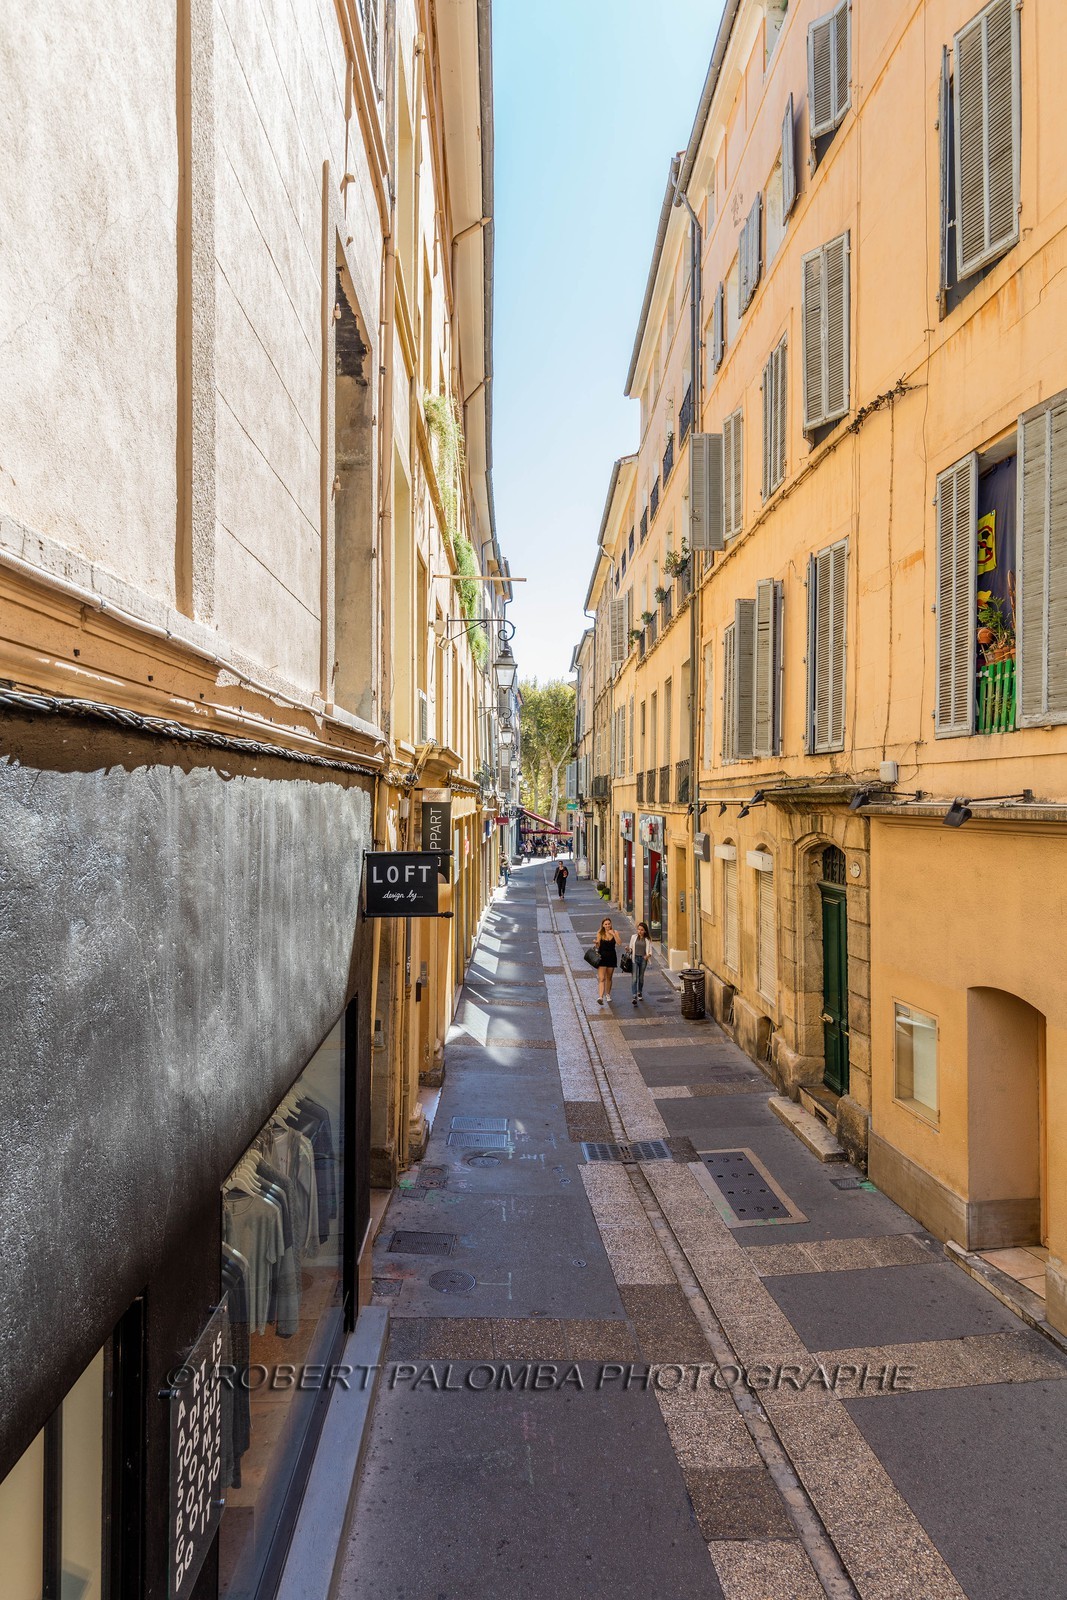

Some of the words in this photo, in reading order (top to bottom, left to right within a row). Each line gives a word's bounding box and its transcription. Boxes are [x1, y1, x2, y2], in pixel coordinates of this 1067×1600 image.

[372, 866, 431, 884] LOFT
[382, 890, 405, 902] design
[213, 1330, 222, 1362] IS
[177, 1427, 186, 1457] A
